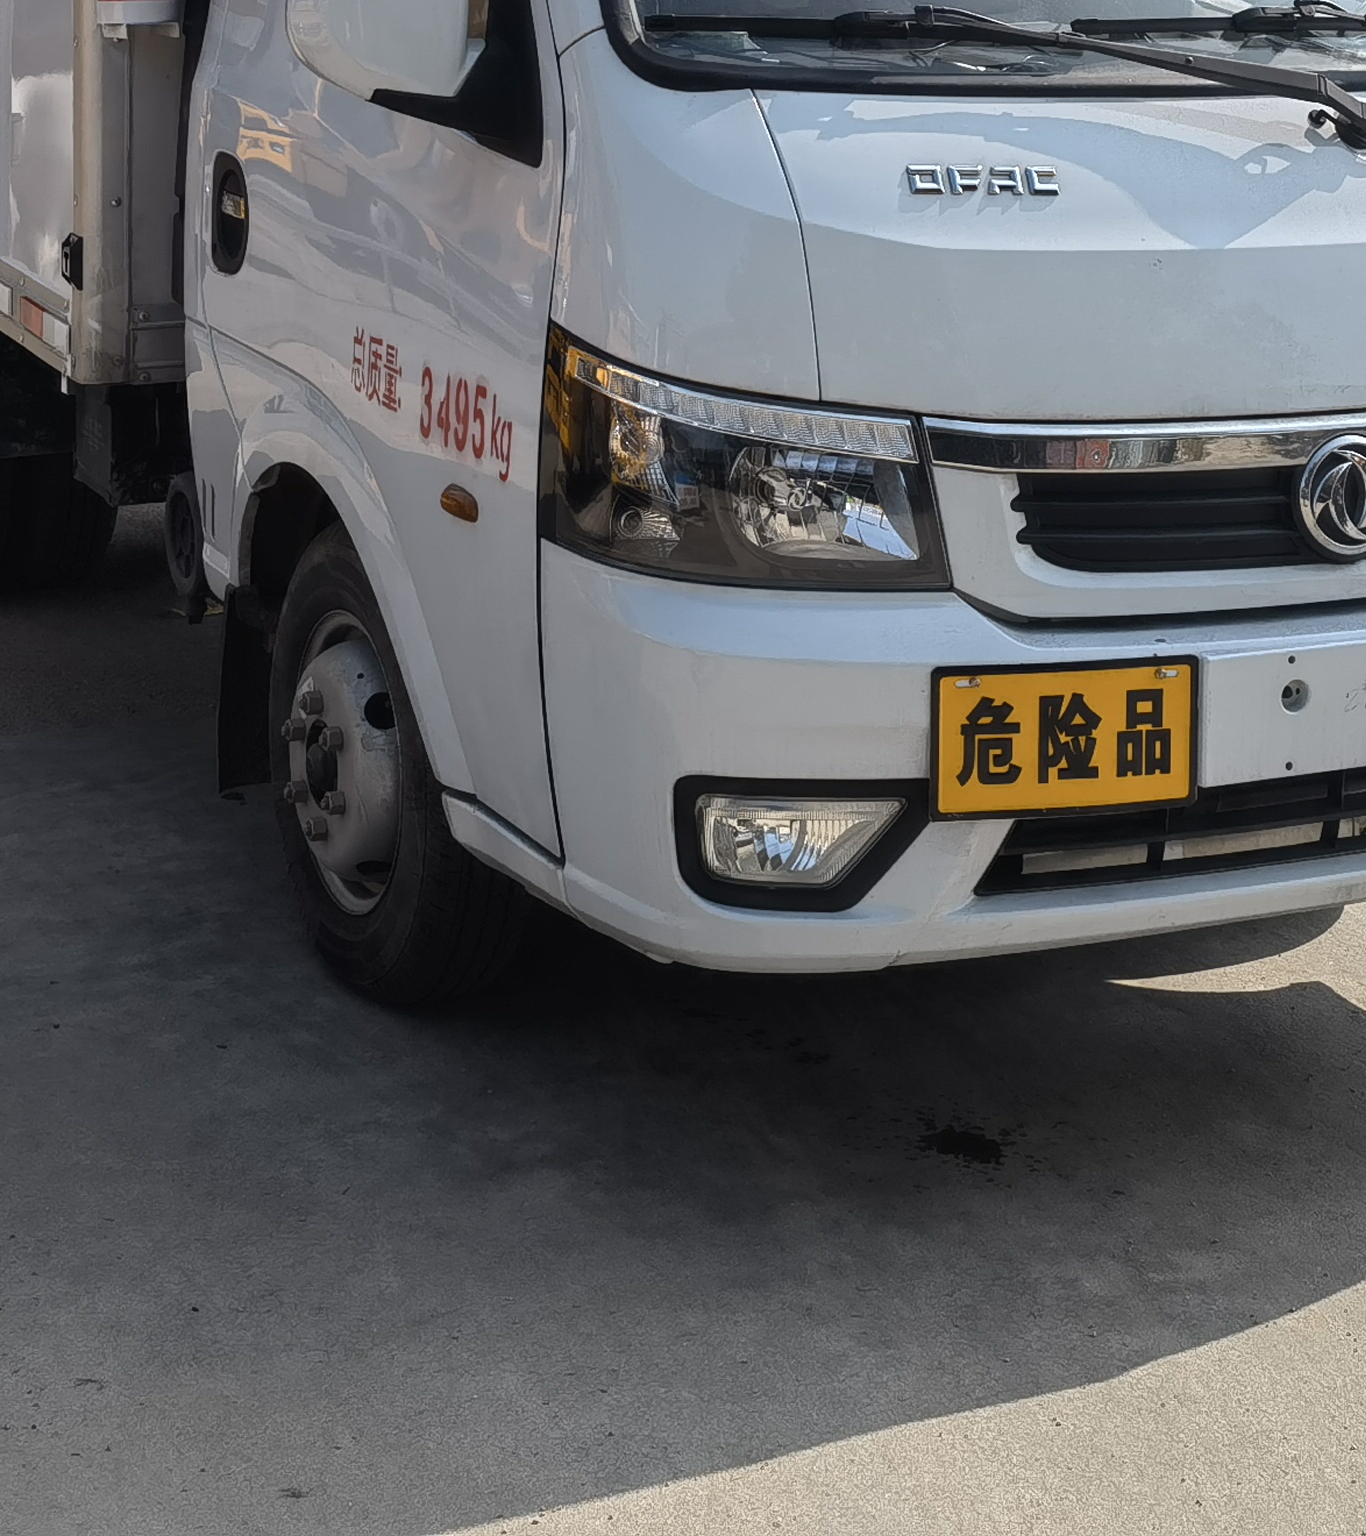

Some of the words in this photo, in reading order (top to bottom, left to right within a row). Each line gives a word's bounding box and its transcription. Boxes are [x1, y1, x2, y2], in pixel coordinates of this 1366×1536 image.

[906, 164, 1060, 196] DFAC
[350, 325, 402, 413] 总质量
[955, 688, 1172, 786] 危险品
